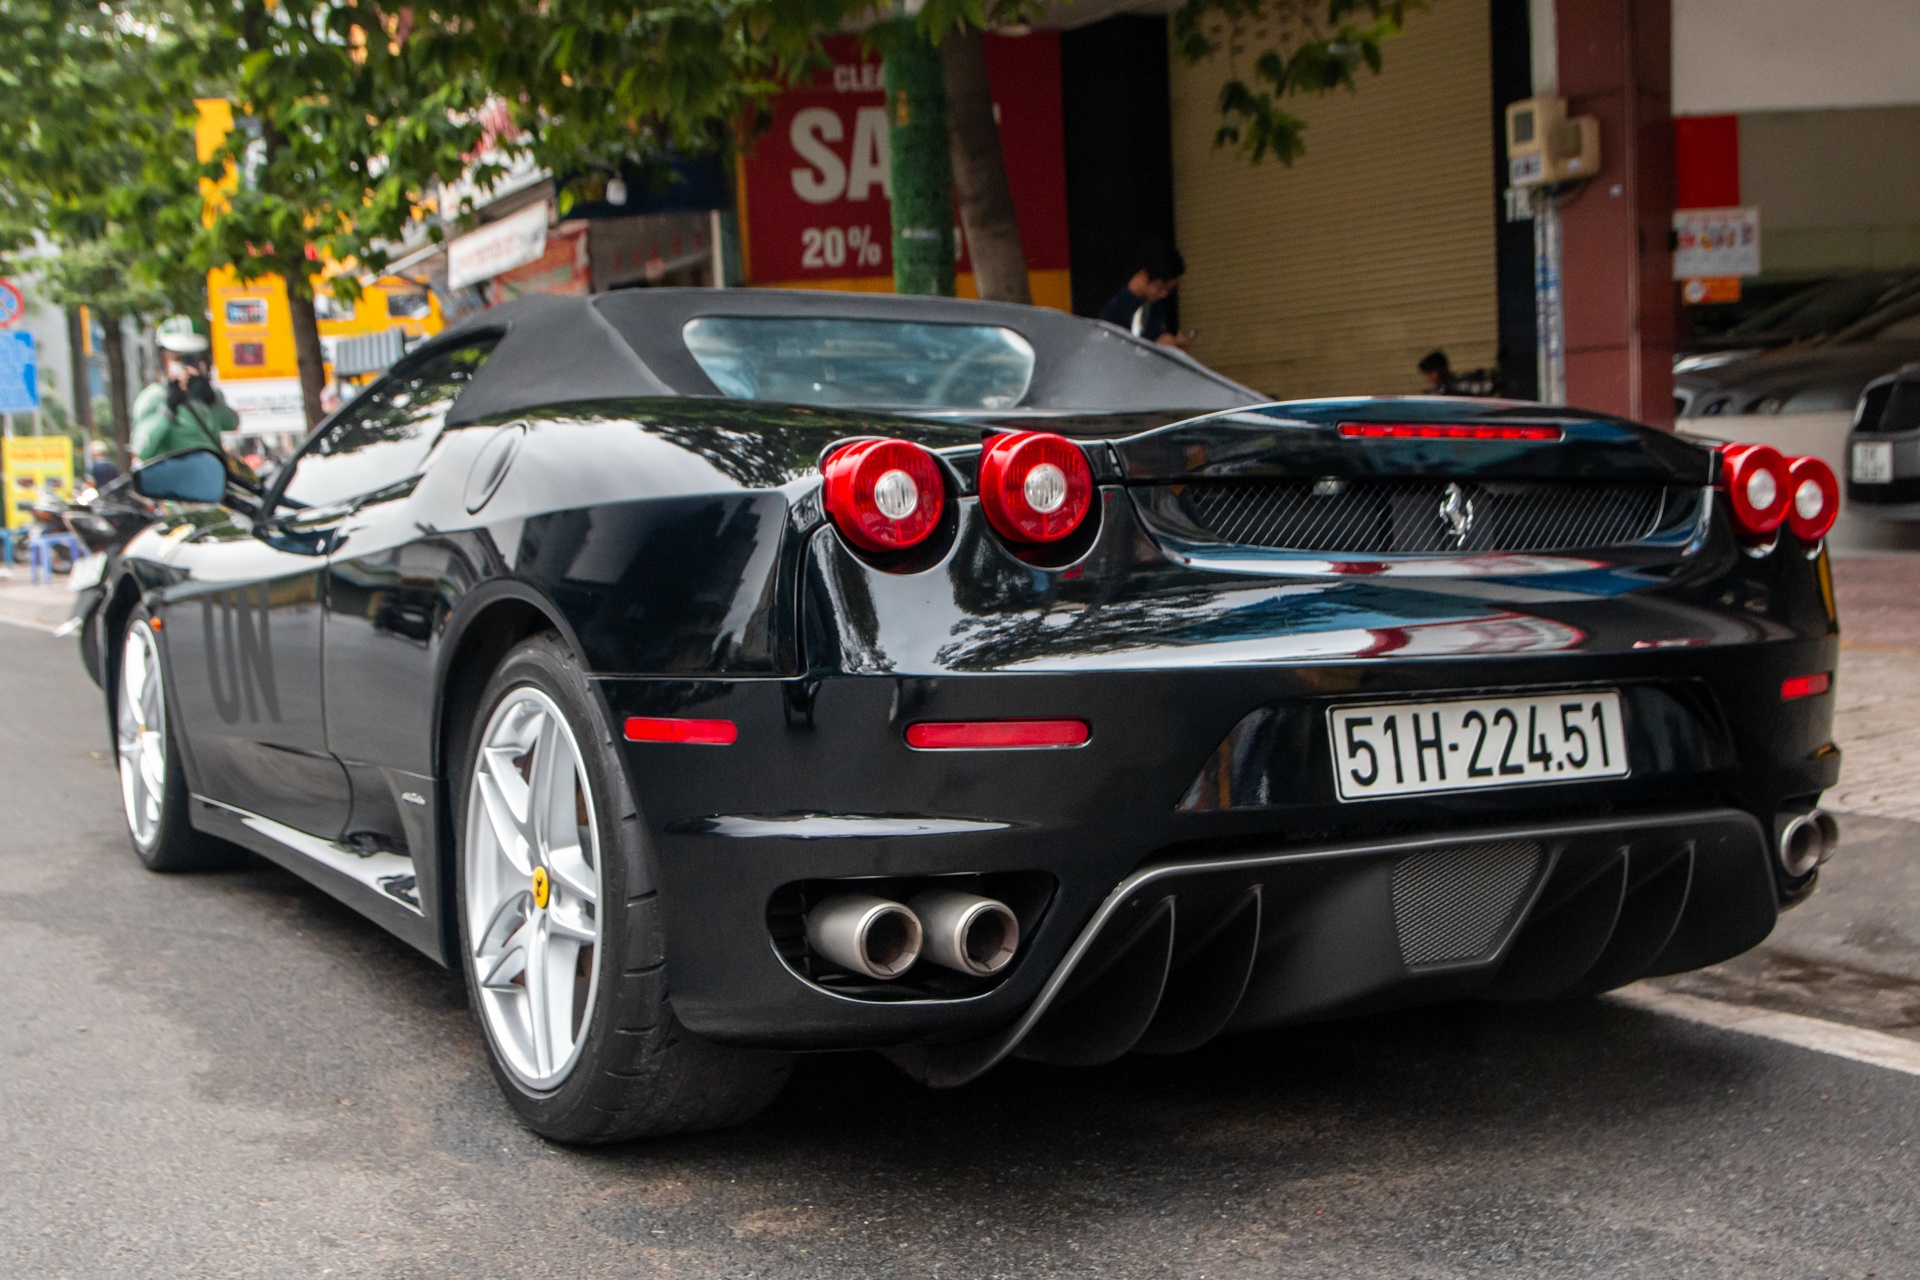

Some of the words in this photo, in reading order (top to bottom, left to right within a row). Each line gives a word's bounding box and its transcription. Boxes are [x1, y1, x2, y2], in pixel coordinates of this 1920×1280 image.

[834, 64, 886, 92] CLEA
[790, 107, 892, 204] SA
[801, 226, 882, 268] 20%
[202, 581, 282, 725] UN
[1345, 702, 1610, 787] 51H-224.51
